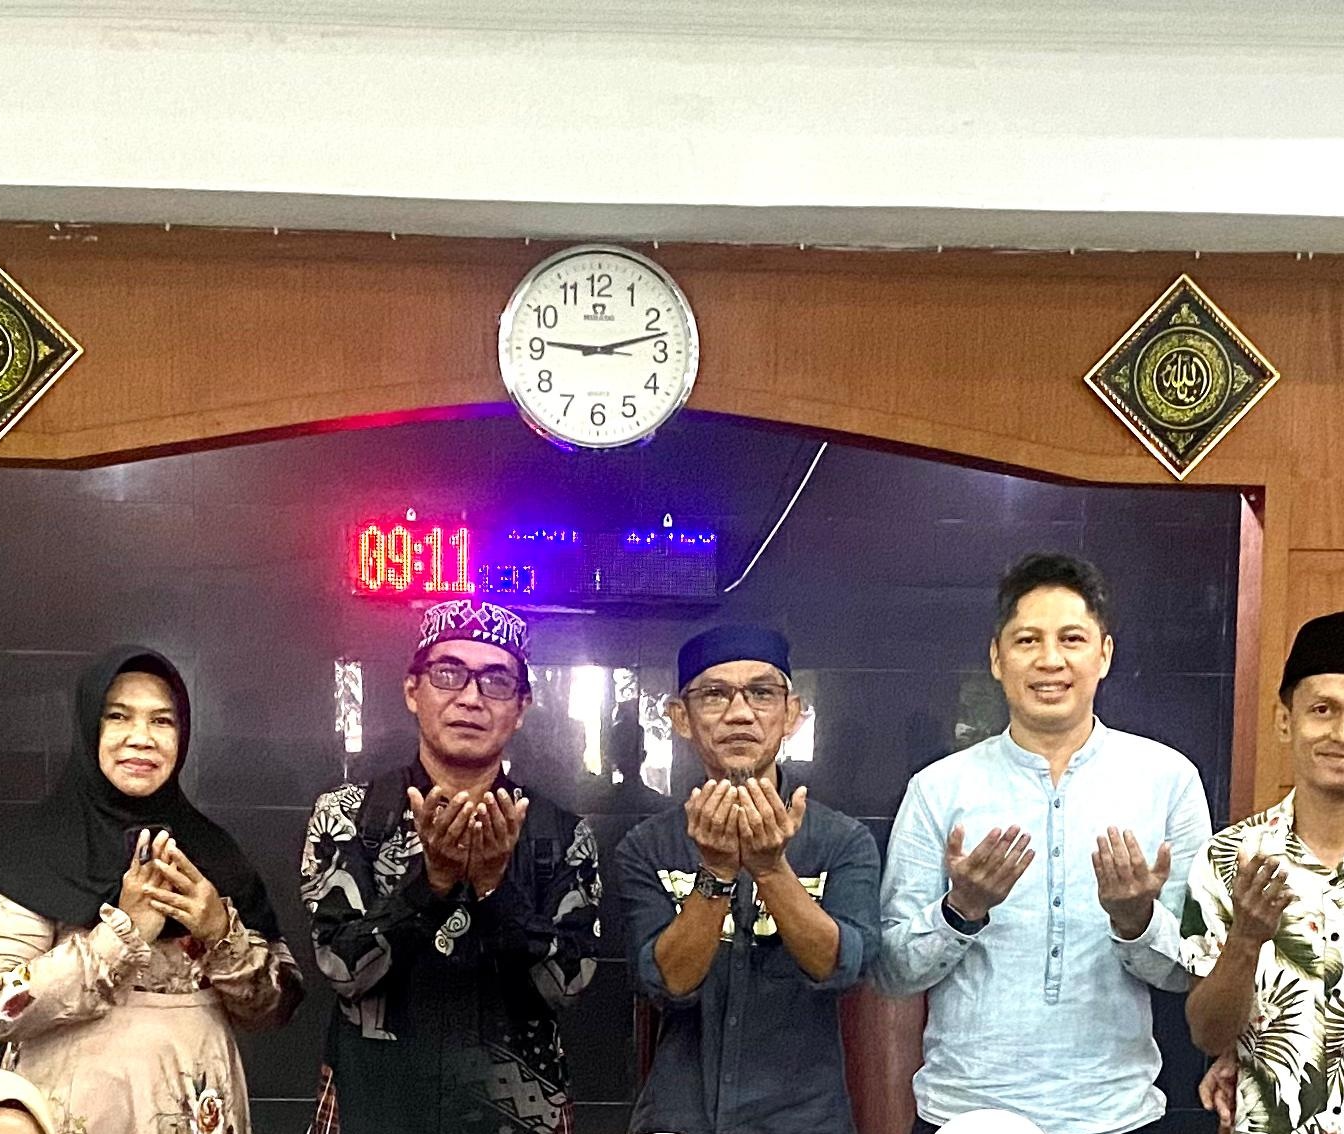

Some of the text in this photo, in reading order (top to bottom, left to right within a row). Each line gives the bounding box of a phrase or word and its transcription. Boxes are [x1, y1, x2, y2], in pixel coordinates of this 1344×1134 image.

[559, 281, 578, 305] 11
[586, 274, 613, 298] 12
[627, 282, 636, 307] 1
[532, 305, 558, 328] 10
[645, 308, 661, 331] 2
[529, 337, 545, 360] 9
[652, 340, 669, 363] 3
[537, 369, 553, 393] 8
[644, 372, 660, 395] 4
[559, 393, 575, 417] 7
[590, 403, 606, 427] 6
[621, 395, 637, 418] 5
[359, 526, 475, 591] 09:11
